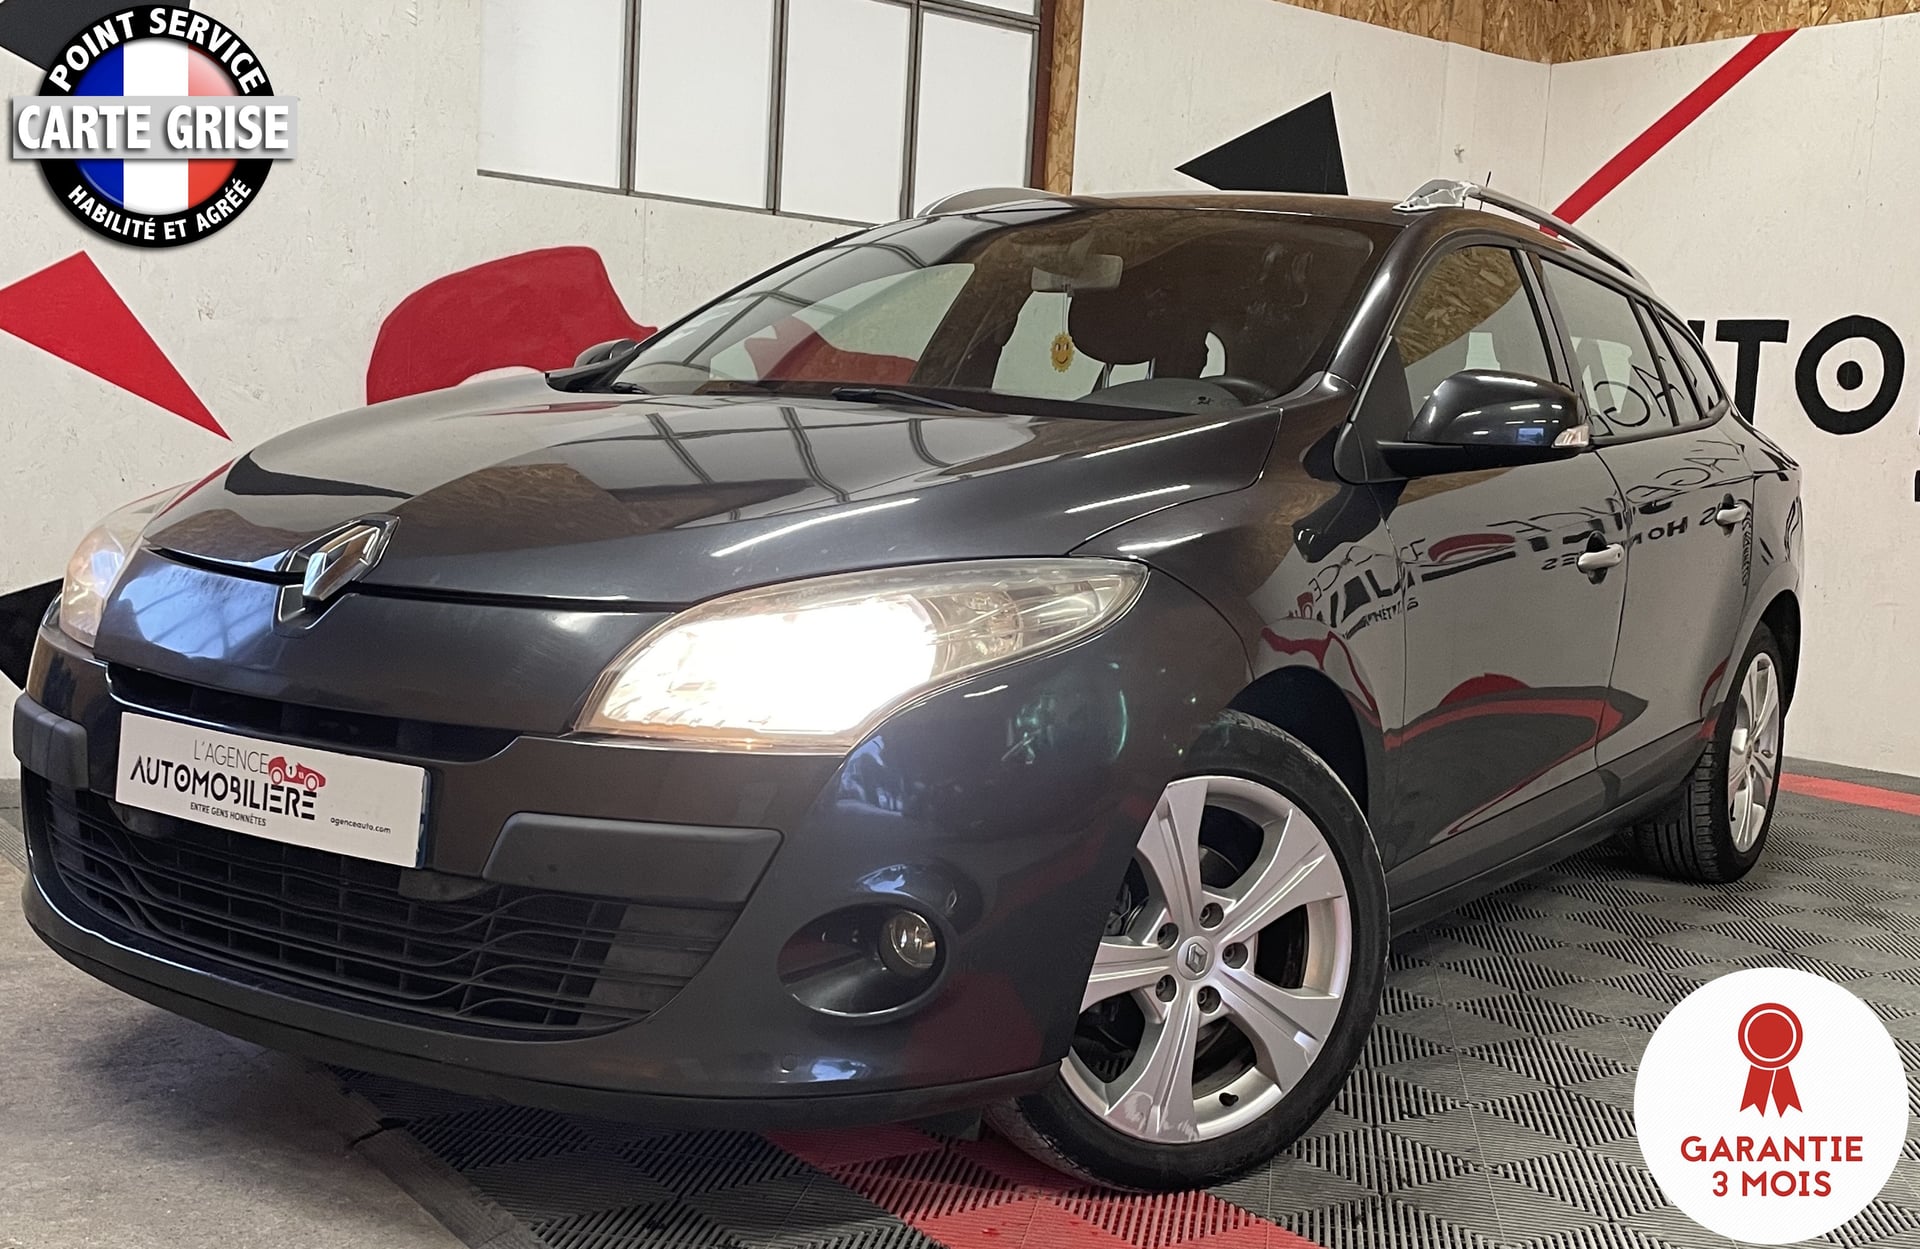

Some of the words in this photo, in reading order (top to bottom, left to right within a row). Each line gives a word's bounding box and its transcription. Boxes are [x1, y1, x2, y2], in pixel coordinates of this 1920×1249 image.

[1687, 315, 1905, 435] TO
[194, 739, 270, 774] L'AGENCE
[190, 801, 210, 814] ENTRE
[210, 807, 229, 818] GENS
[330, 816, 391, 834] agenceauto.com
